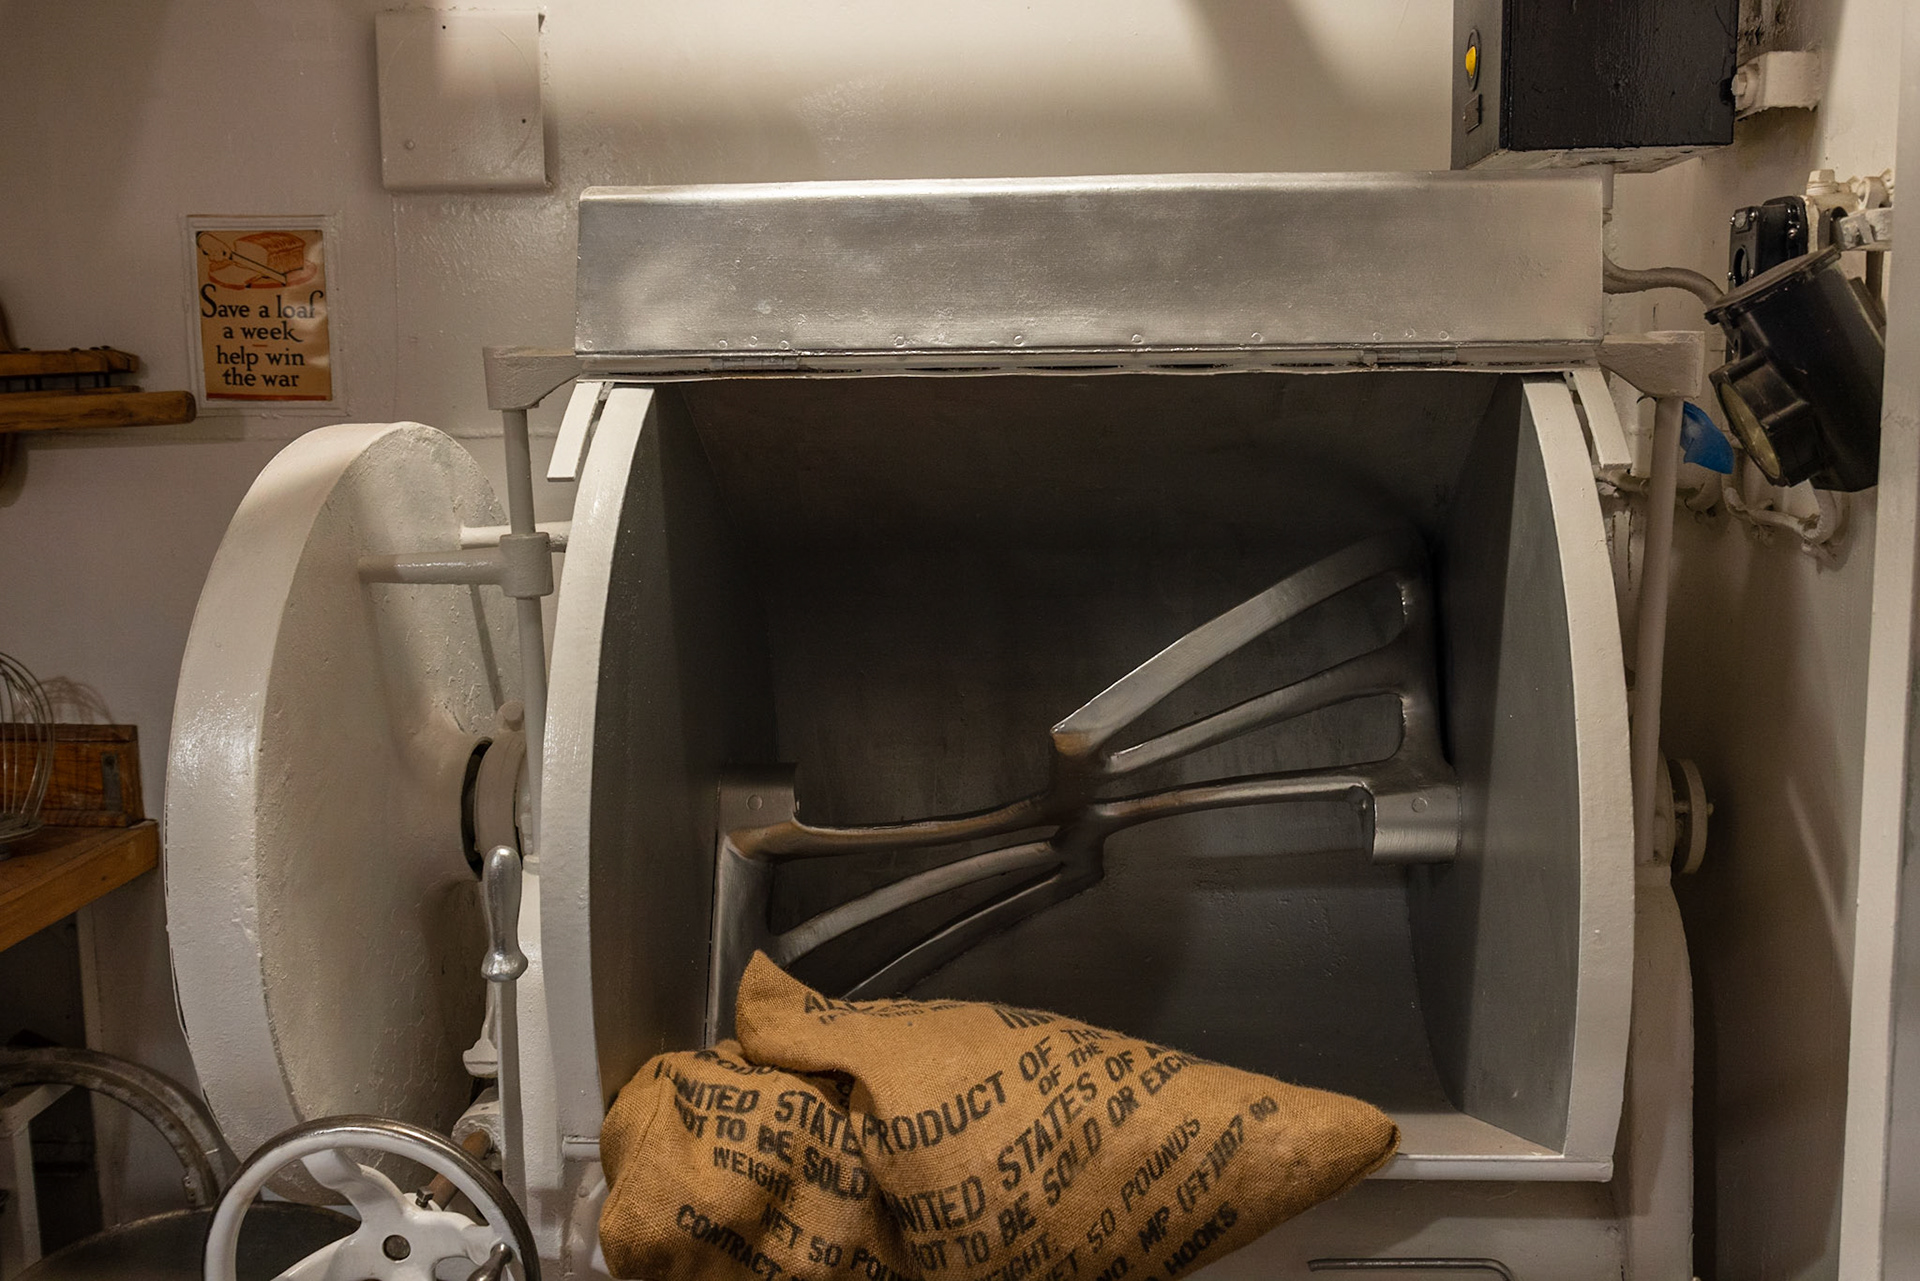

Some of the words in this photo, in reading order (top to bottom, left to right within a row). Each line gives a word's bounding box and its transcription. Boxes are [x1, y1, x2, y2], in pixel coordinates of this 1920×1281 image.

[201, 284, 250, 319] Save
[259, 305, 270, 319] a
[276, 290, 324, 319] loaf
[223, 326, 234, 339] a
[241, 321, 303, 342] week
[216, 345, 259, 371] help
[265, 348, 305, 366] win
[222, 367, 257, 386] the
[261, 374, 299, 387] war
[861, 1070, 1005, 1156] PRODUCT
[1018, 1036, 1052, 1082] OF
[1037, 1065, 1063, 1097] OF
[1067, 1041, 1104, 1068] THE
[773, 1090, 863, 1157] STATE
[998, 1072, 1099, 1191] STATES
[1105, 1050, 1135, 1083] OF
[715, 1114, 748, 1143] TO
[757, 1124, 795, 1167] BE
[802, 1146, 872, 1202] SOLD
[956, 1229, 990, 1270] TO
[998, 1190, 1037, 1247] BE
[1041, 1116, 1102, 1207] SOLD
[1106, 1086, 1140, 1128] OR
[1085, 1208, 1117, 1254] 50
[1119, 1117, 1201, 1213] POUNDS
[676, 1204, 783, 1281] CONTRACT
[760, 1202, 804, 1250] NET
[807, 1235, 843, 1269] 50
[1163, 1200, 1239, 1276] HOOKS
